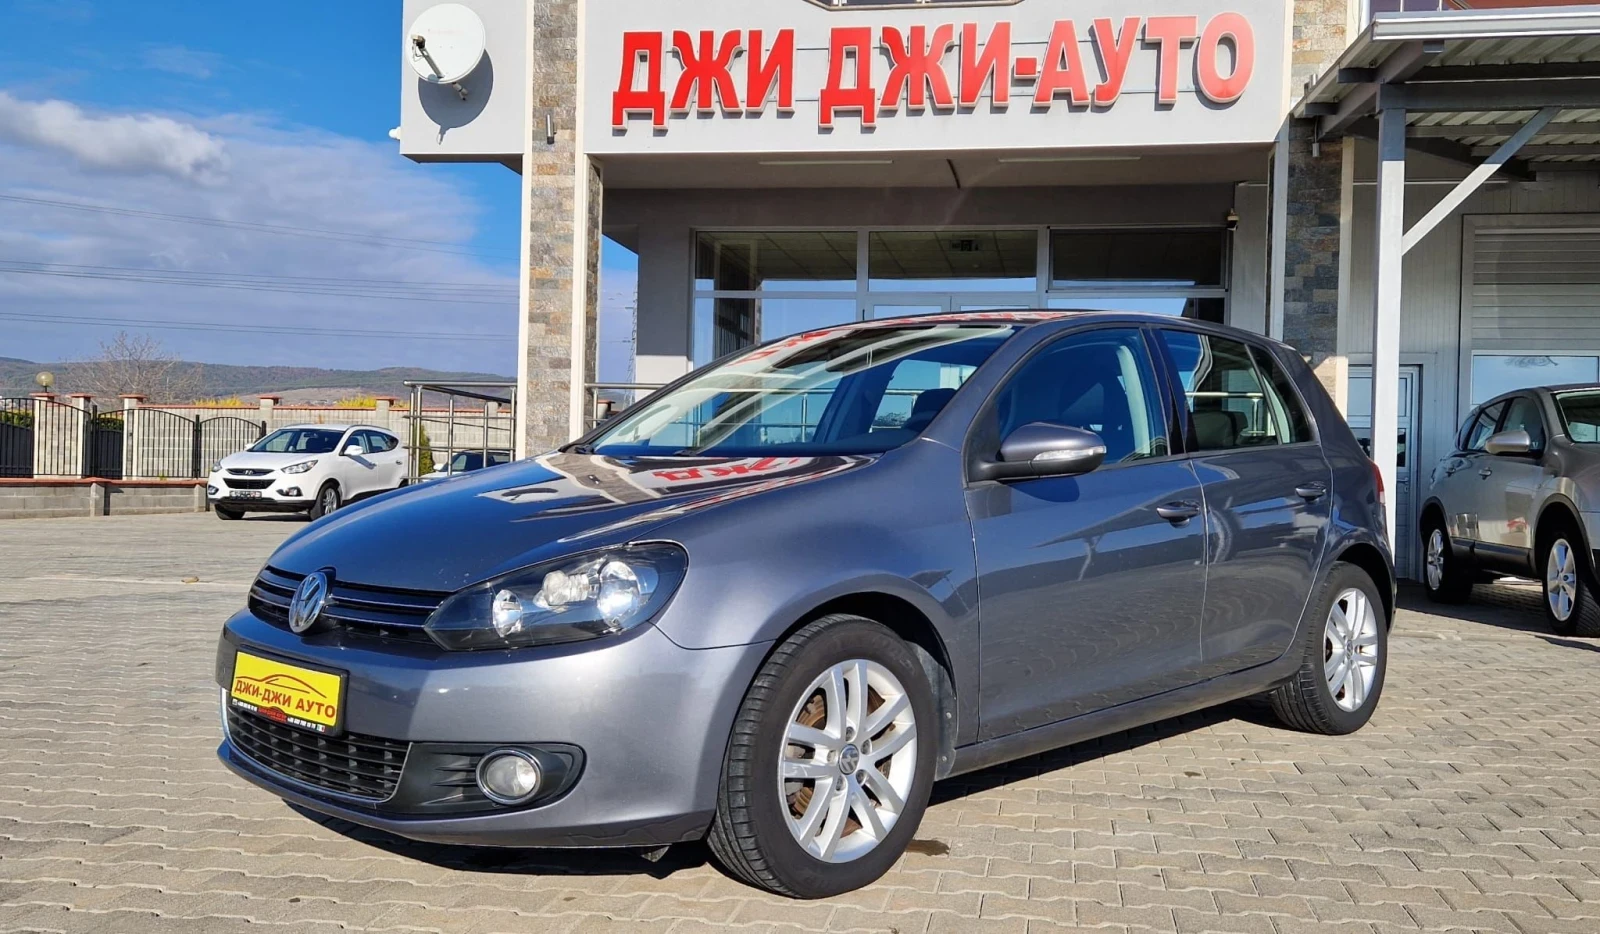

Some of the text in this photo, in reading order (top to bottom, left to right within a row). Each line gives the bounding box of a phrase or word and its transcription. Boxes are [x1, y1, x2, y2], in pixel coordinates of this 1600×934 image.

[612, 12, 1255, 132] ДЖИ ДЖИ-АУТО
[234, 680, 292, 708] ДЖИ-ДЖИ
[296, 698, 336, 719] АУТО
